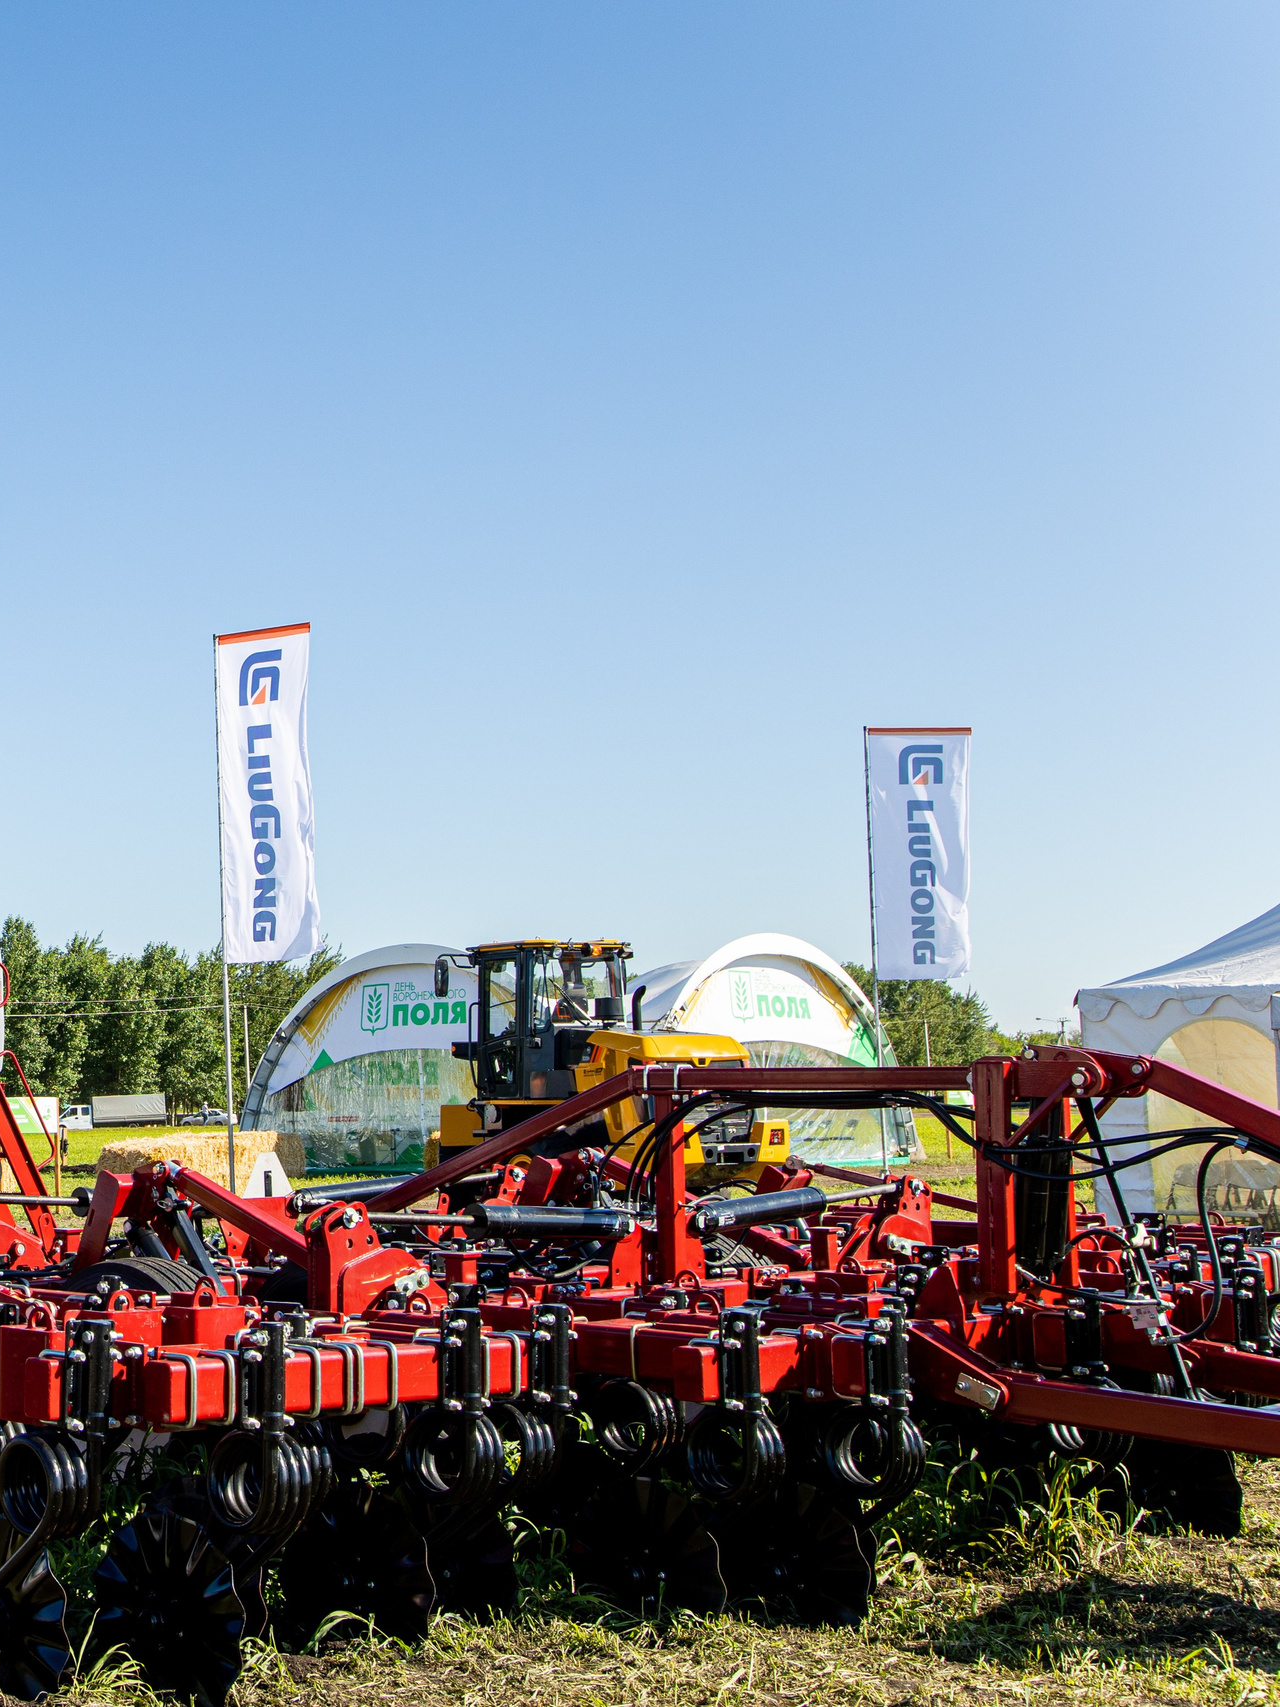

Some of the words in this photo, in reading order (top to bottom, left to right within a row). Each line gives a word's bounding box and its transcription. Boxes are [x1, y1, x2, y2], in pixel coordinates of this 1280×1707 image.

[393, 988, 467, 1002] ВОРОНЕЖОГО
[394, 982, 416, 992] ДЕНЬ
[392, 1001, 467, 1027] ПОЛЯ
[756, 994, 812, 1020] ПОЛЯ
